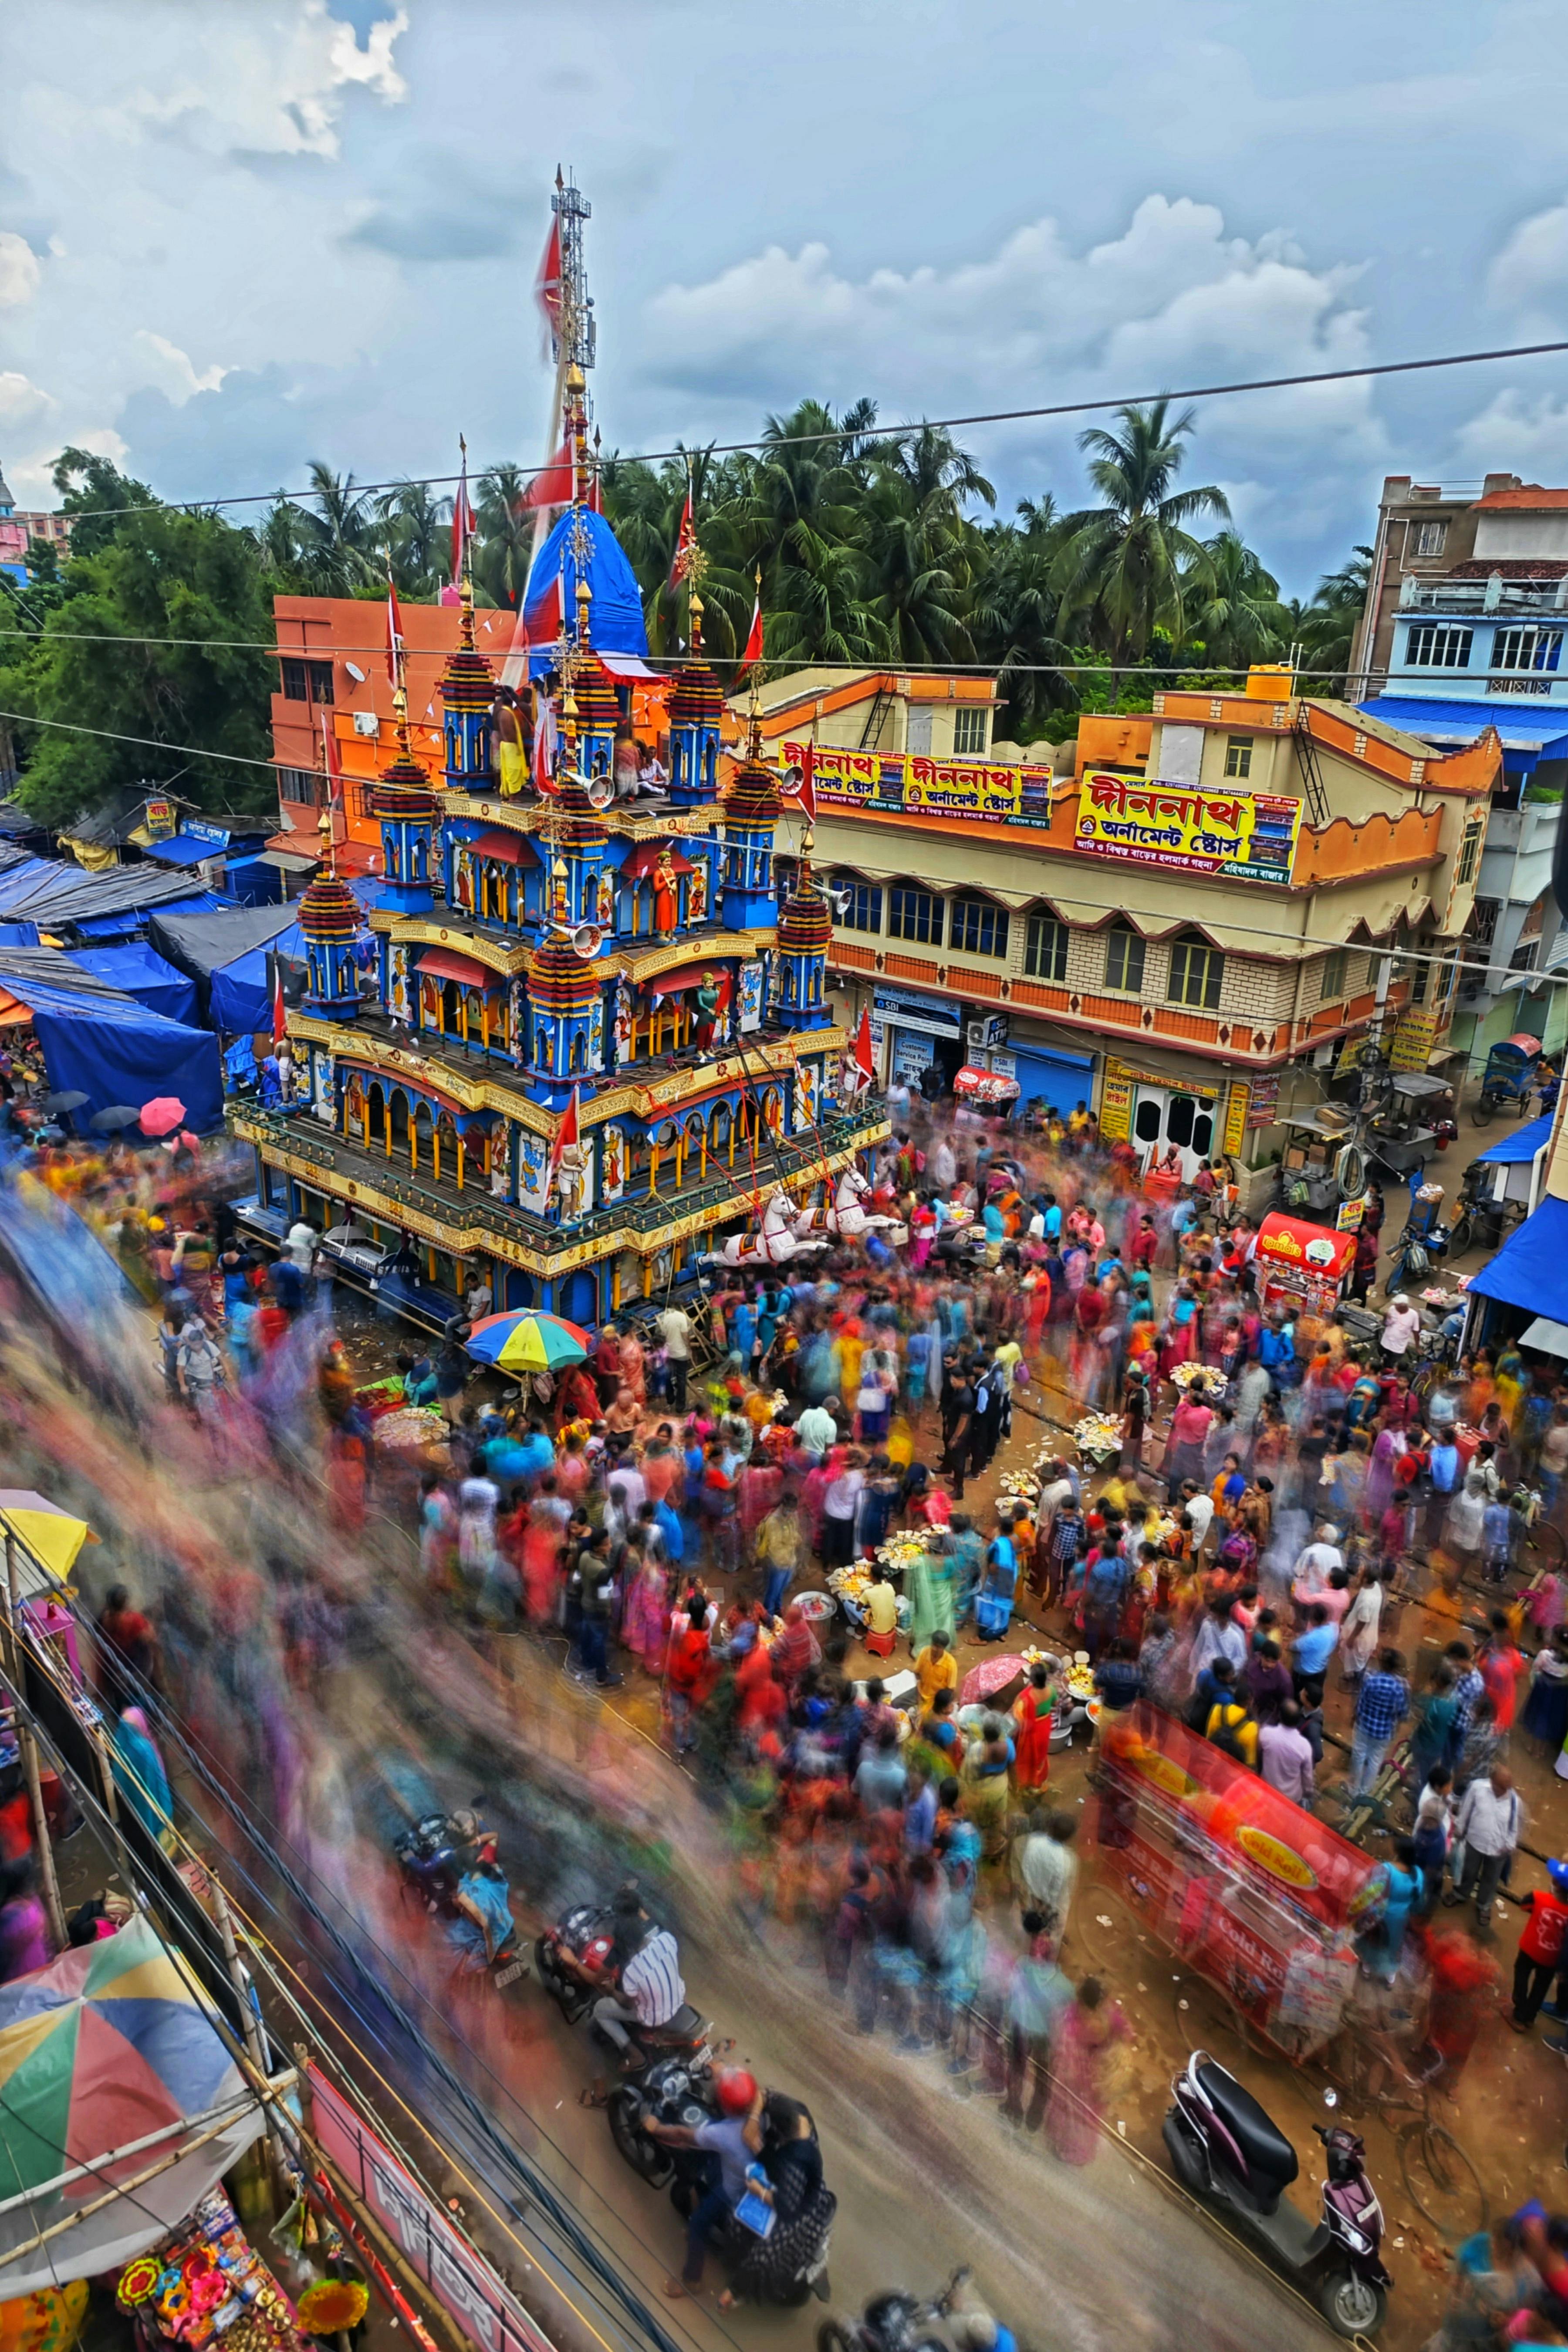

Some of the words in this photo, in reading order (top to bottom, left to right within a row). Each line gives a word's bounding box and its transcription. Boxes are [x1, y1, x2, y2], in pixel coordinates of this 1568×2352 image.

[910, 757, 1017, 793] দীননাথ
[1086, 775, 1247, 833] দীননাথ
[1076, 840, 1095, 850] আদি
[1131, 848, 1156, 862] বাড়ের
[1159, 852, 1190, 866] হলমার্ক
[1191, 858, 1213, 870] গহনা
[1224, 863, 1258, 877] মহিষাদল
[885, 1001, 899, 1012] SBI
[988, 1027, 1007, 1043] ATM
[896, 1049, 916, 1060] Service
[918, 1054, 932, 1063] Point
[902, 1041, 928, 1053] Customer
[1243, 1832, 1273, 1860] Cold
[1273, 1852, 1304, 1880] Roll
[1218, 1916, 1258, 1955] Cold
